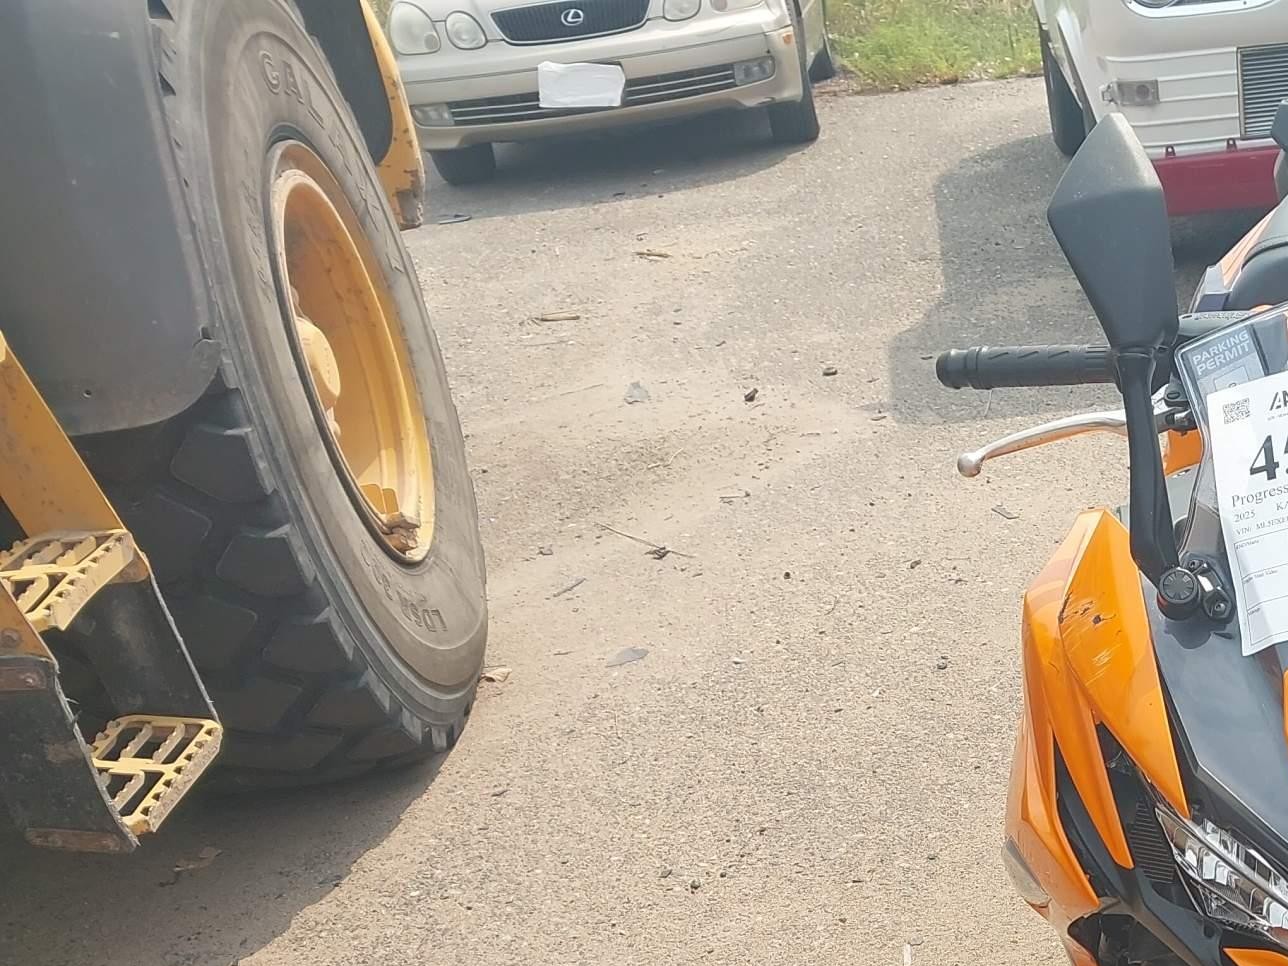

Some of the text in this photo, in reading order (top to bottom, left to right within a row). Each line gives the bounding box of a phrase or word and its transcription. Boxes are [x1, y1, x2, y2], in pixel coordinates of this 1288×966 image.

[1192, 330, 1249, 365] PARKING
[1196, 341, 1250, 376] PERMIT
[1234, 510, 1256, 523] 2025
